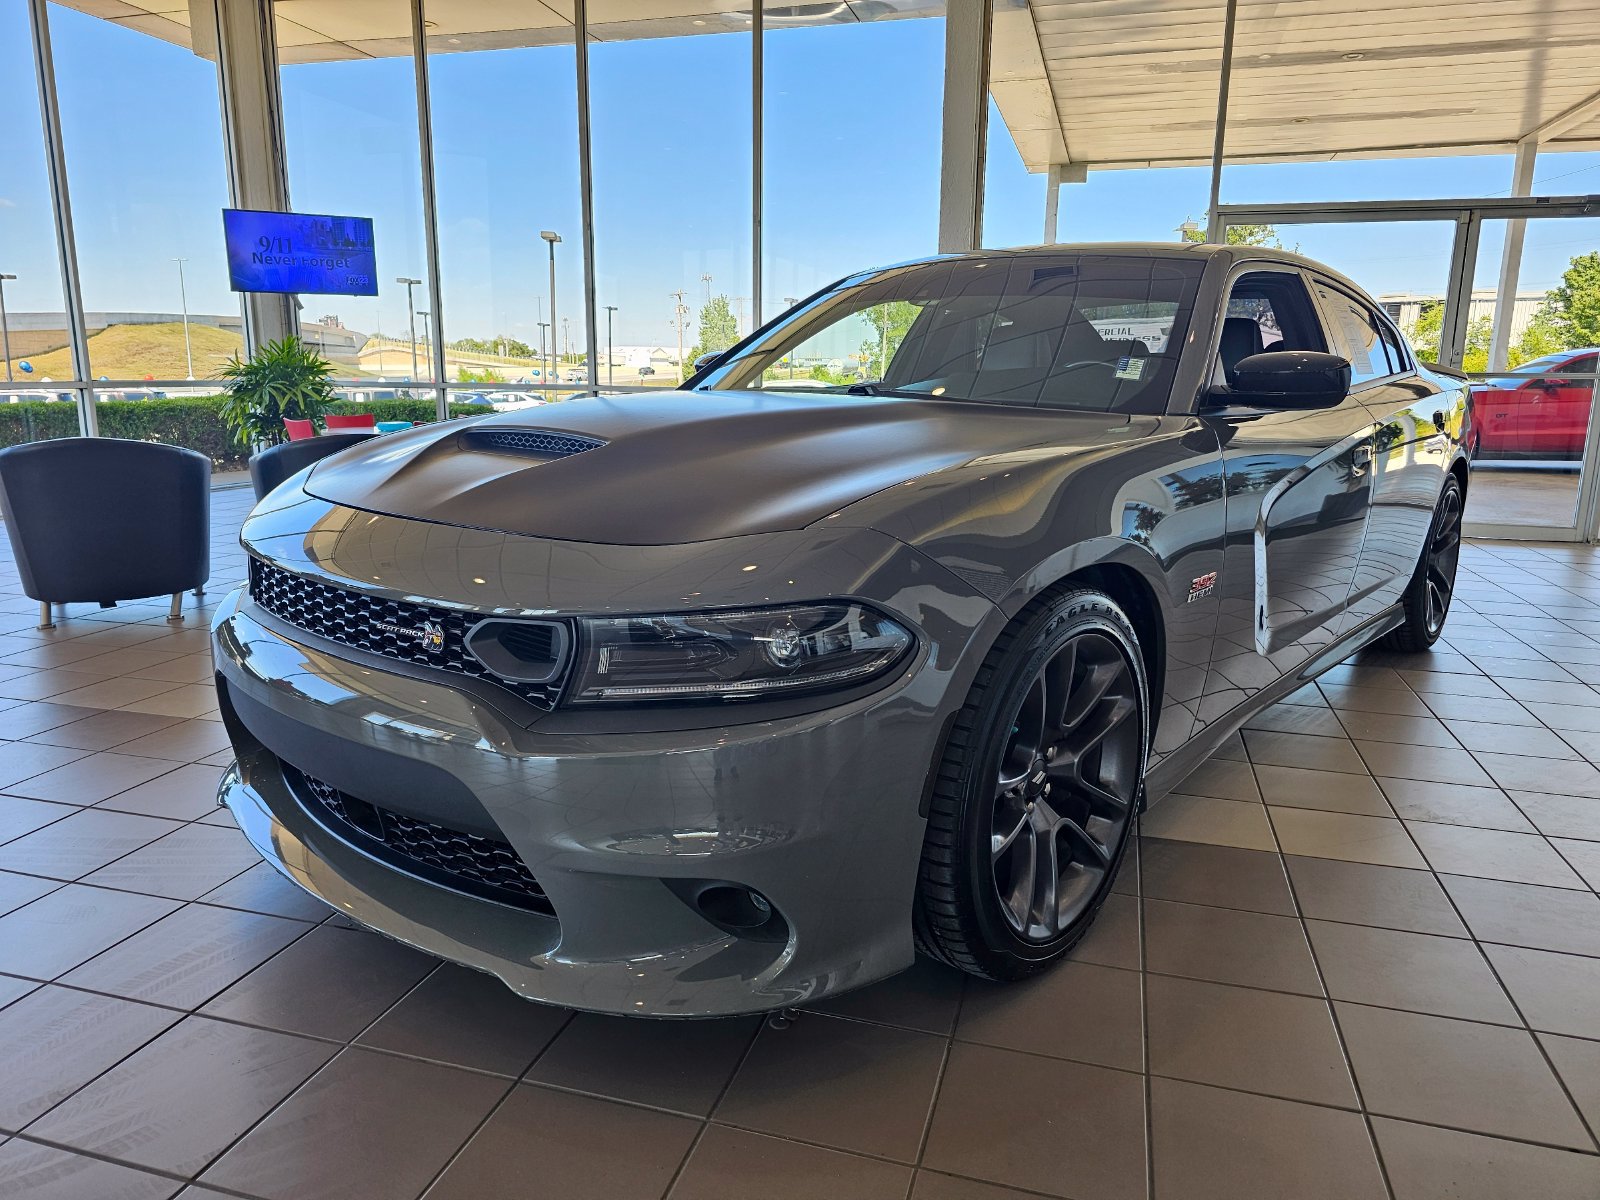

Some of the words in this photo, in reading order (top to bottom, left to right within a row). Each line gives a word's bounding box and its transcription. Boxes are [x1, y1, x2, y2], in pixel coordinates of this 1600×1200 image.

[258, 235, 292, 254] 9/11
[252, 252, 297, 266] Never
[302, 255, 351, 270] Forget
[1189, 571, 1217, 593] 392
[1187, 585, 1214, 603] HEMI
[1045, 603, 1099, 639] EAGLE
[376, 623, 400, 632] SCAT
[400, 628, 424, 638] PACK
